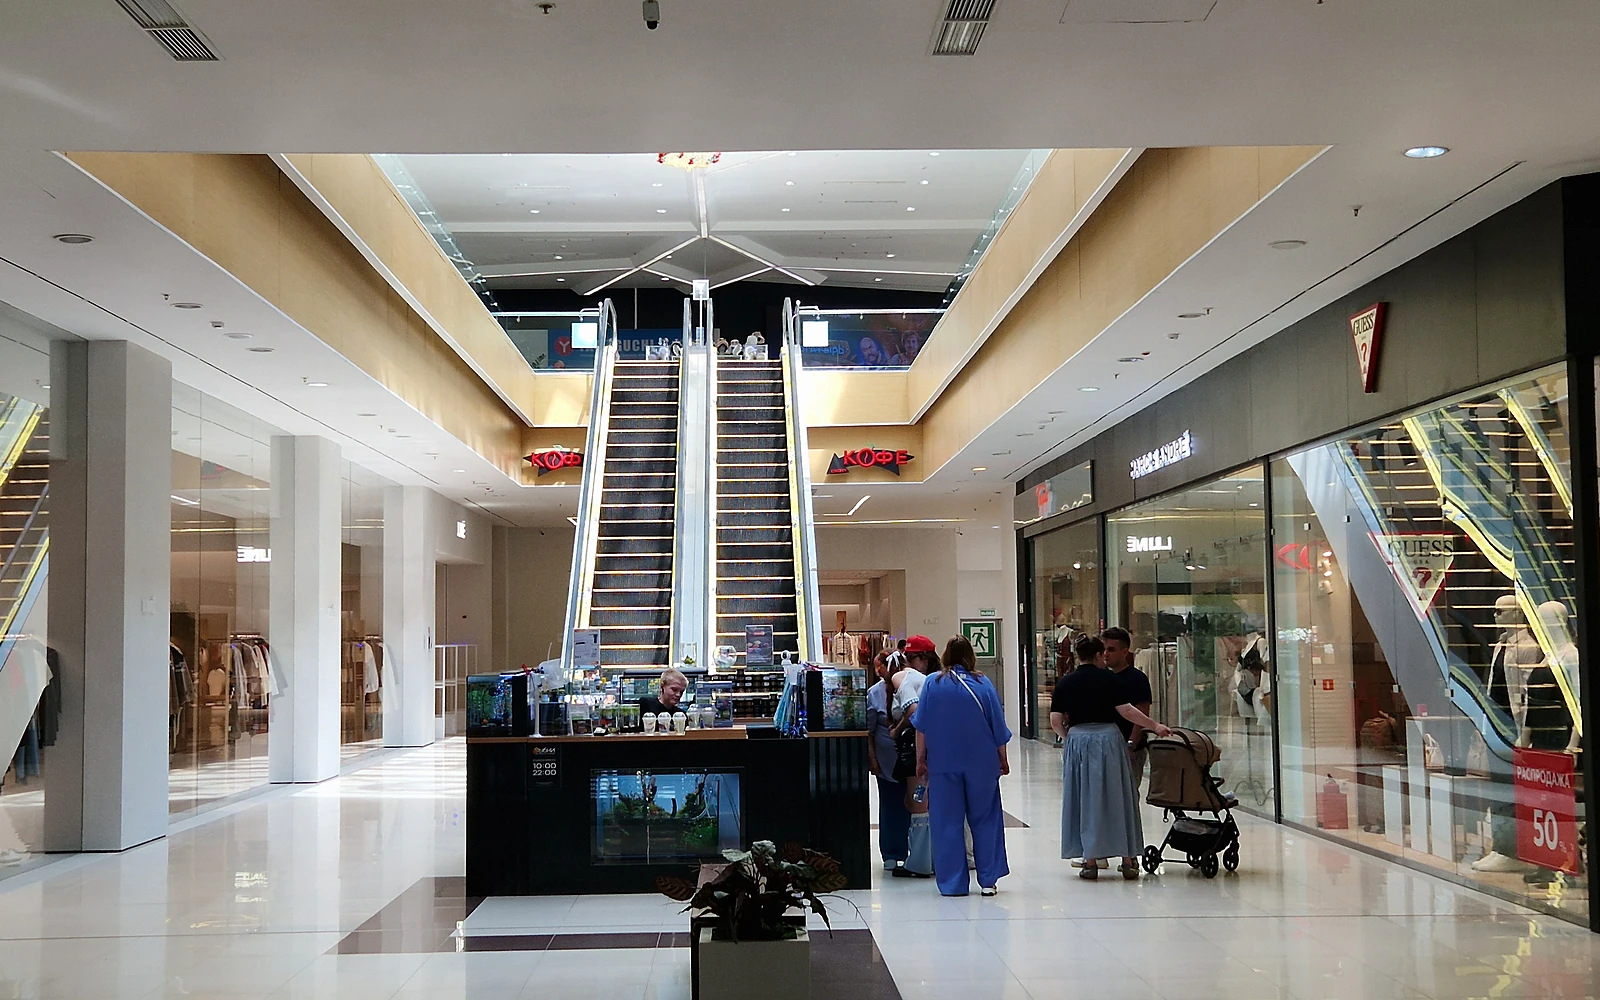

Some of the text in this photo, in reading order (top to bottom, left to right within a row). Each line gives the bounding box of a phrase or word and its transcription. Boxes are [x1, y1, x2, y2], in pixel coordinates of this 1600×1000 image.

[1353, 313, 1374, 336] GUESS
[531, 450, 582, 470] КОФ
[843, 447, 908, 468] КОФЕ
[1387, 539, 1453, 558] GUESS
[532, 762, 557, 770] 10:00
[1516, 766, 1571, 789] РАСПРОДАЖА
[1533, 808, 1559, 851] 50
